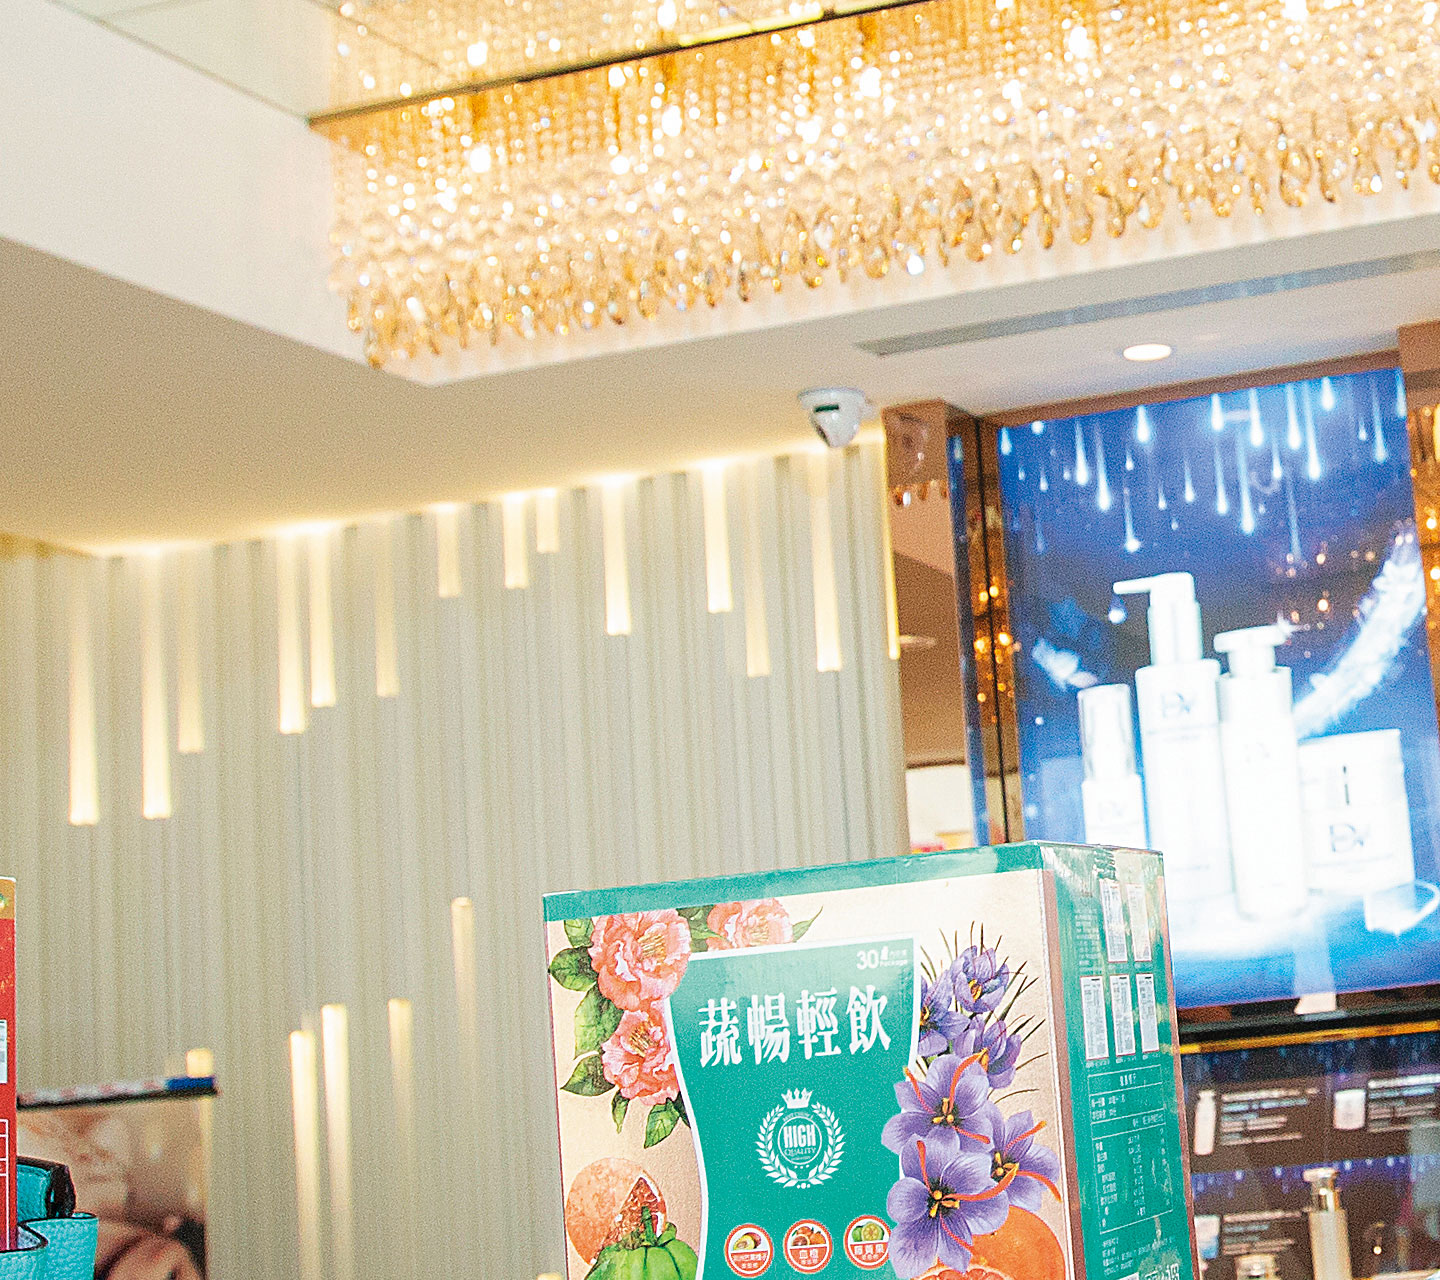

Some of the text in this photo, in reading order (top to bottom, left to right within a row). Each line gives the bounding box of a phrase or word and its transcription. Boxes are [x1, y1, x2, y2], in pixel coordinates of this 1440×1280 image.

[856, 949, 879, 970] 30
[698, 984, 891, 1068] 蔬暢輕飲
[783, 1124, 817, 1148] HIGH
